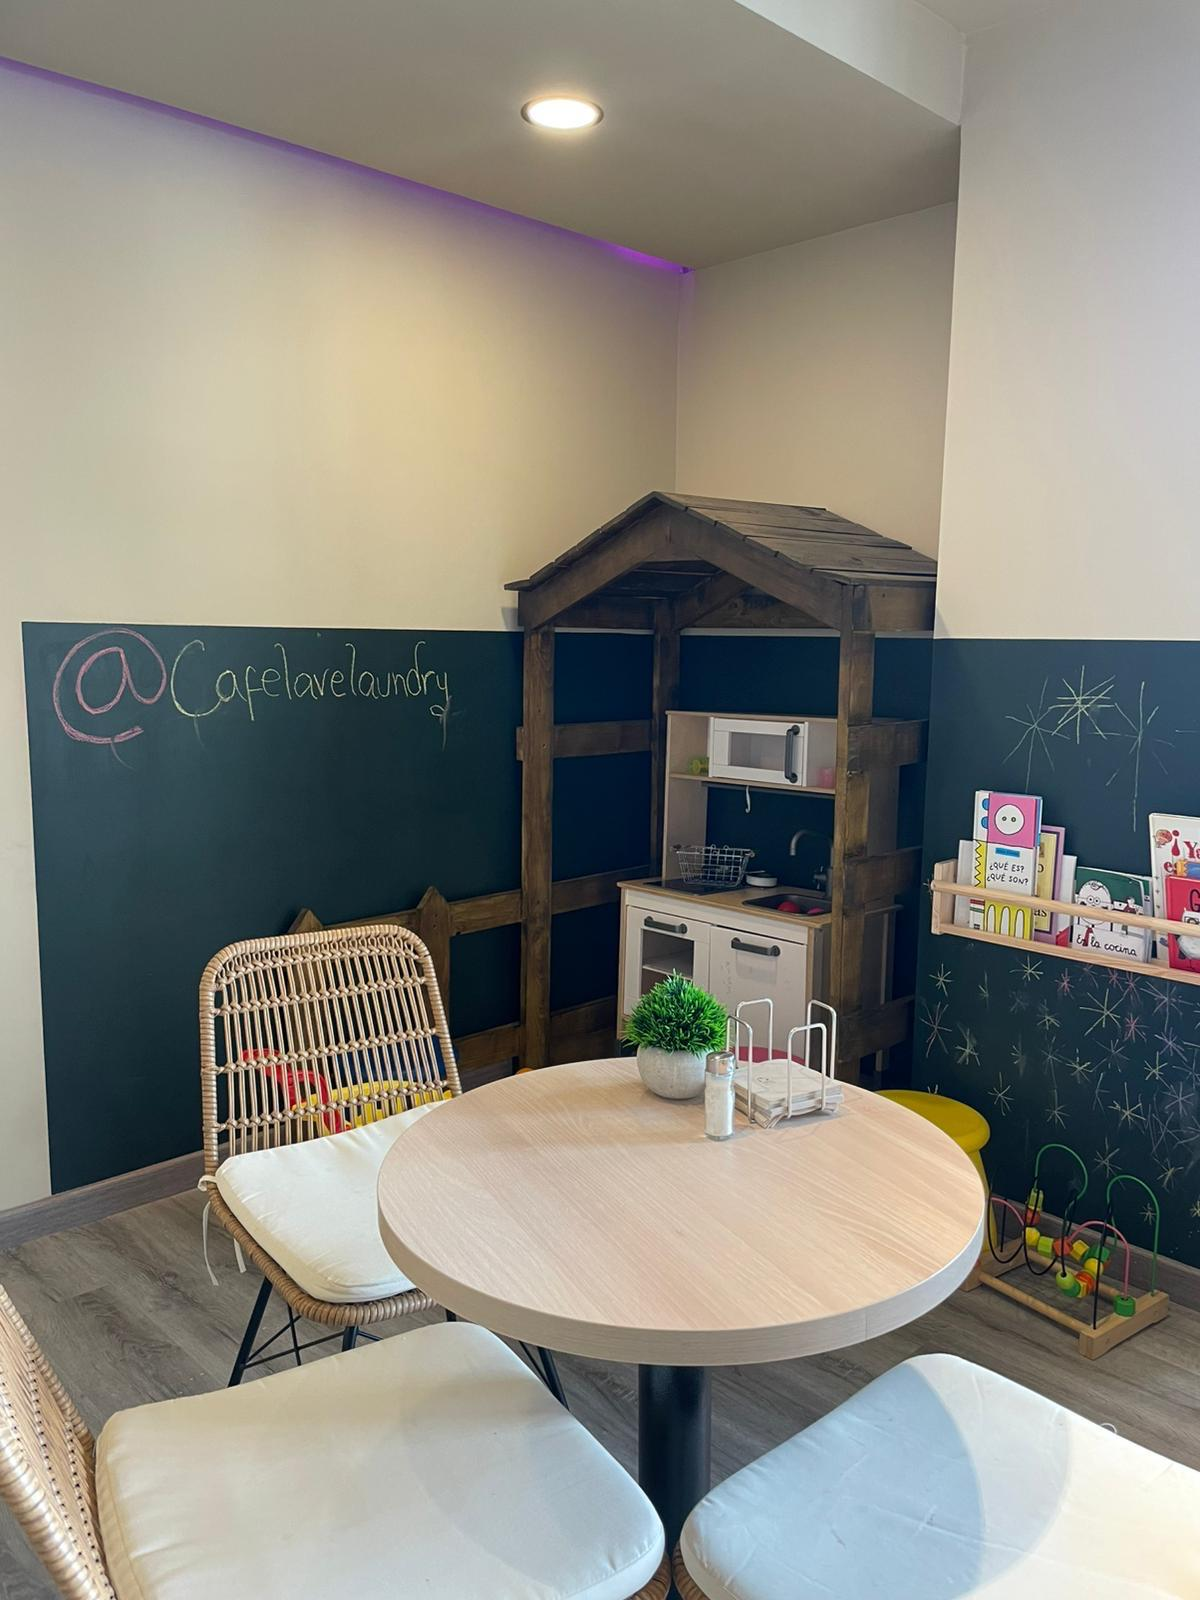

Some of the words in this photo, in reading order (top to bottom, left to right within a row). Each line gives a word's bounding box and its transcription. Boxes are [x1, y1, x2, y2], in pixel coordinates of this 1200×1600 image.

[1011, 864, 1025, 873] ES?
[1008, 875, 1029, 886] SON?
[1090, 936, 1101, 948] la
[1104, 943, 1137, 957] cocina
